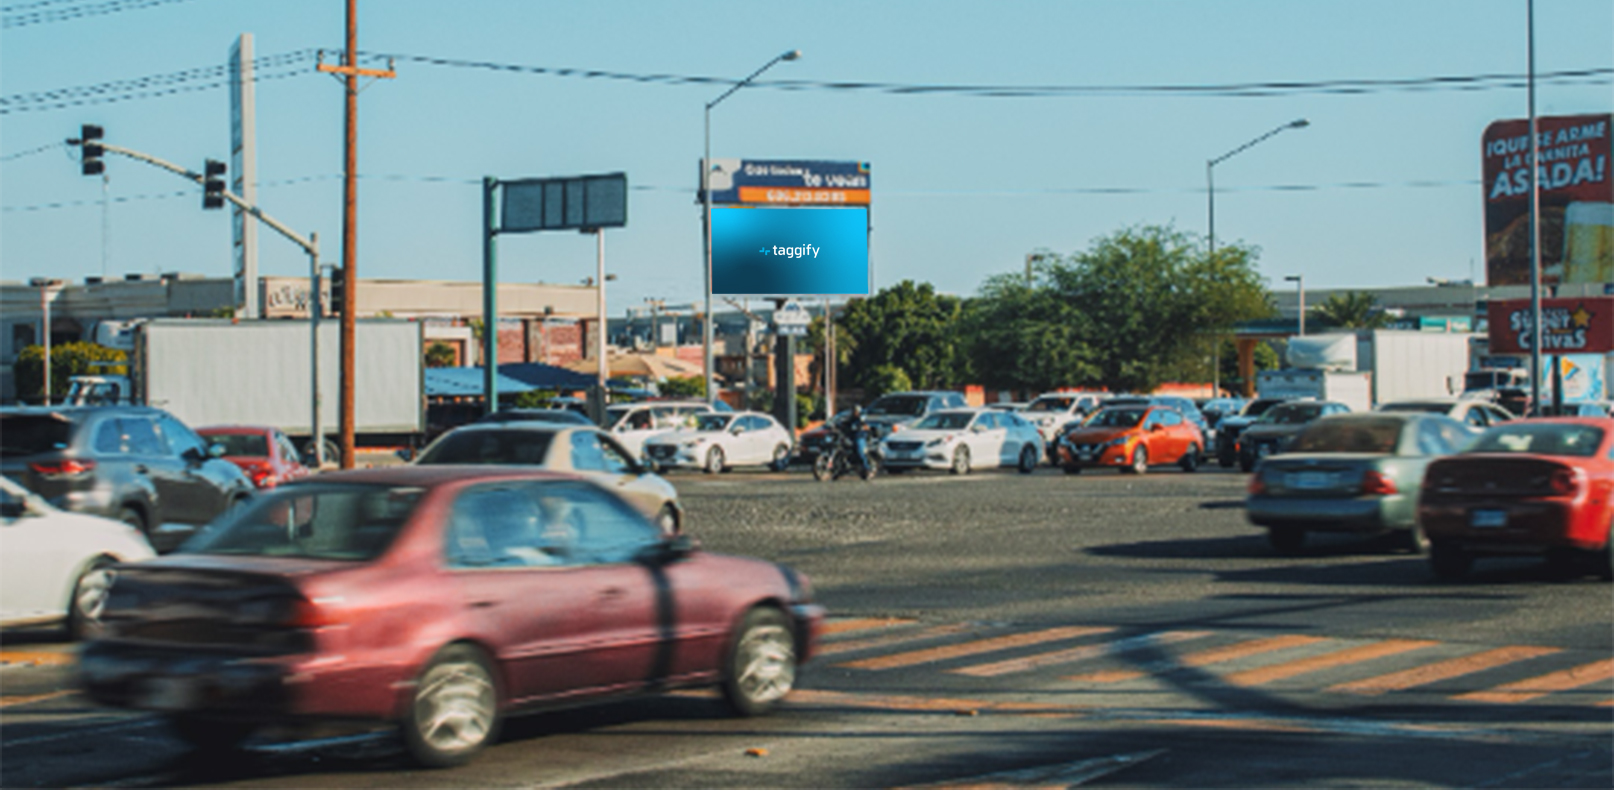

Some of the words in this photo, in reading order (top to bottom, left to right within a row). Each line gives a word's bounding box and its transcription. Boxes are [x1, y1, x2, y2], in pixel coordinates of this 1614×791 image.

[1555, 121, 1606, 145] ARME
[1503, 154, 1522, 170] LA
[1489, 154, 1606, 199] ASADA!
[772, 243, 820, 259] taggify
